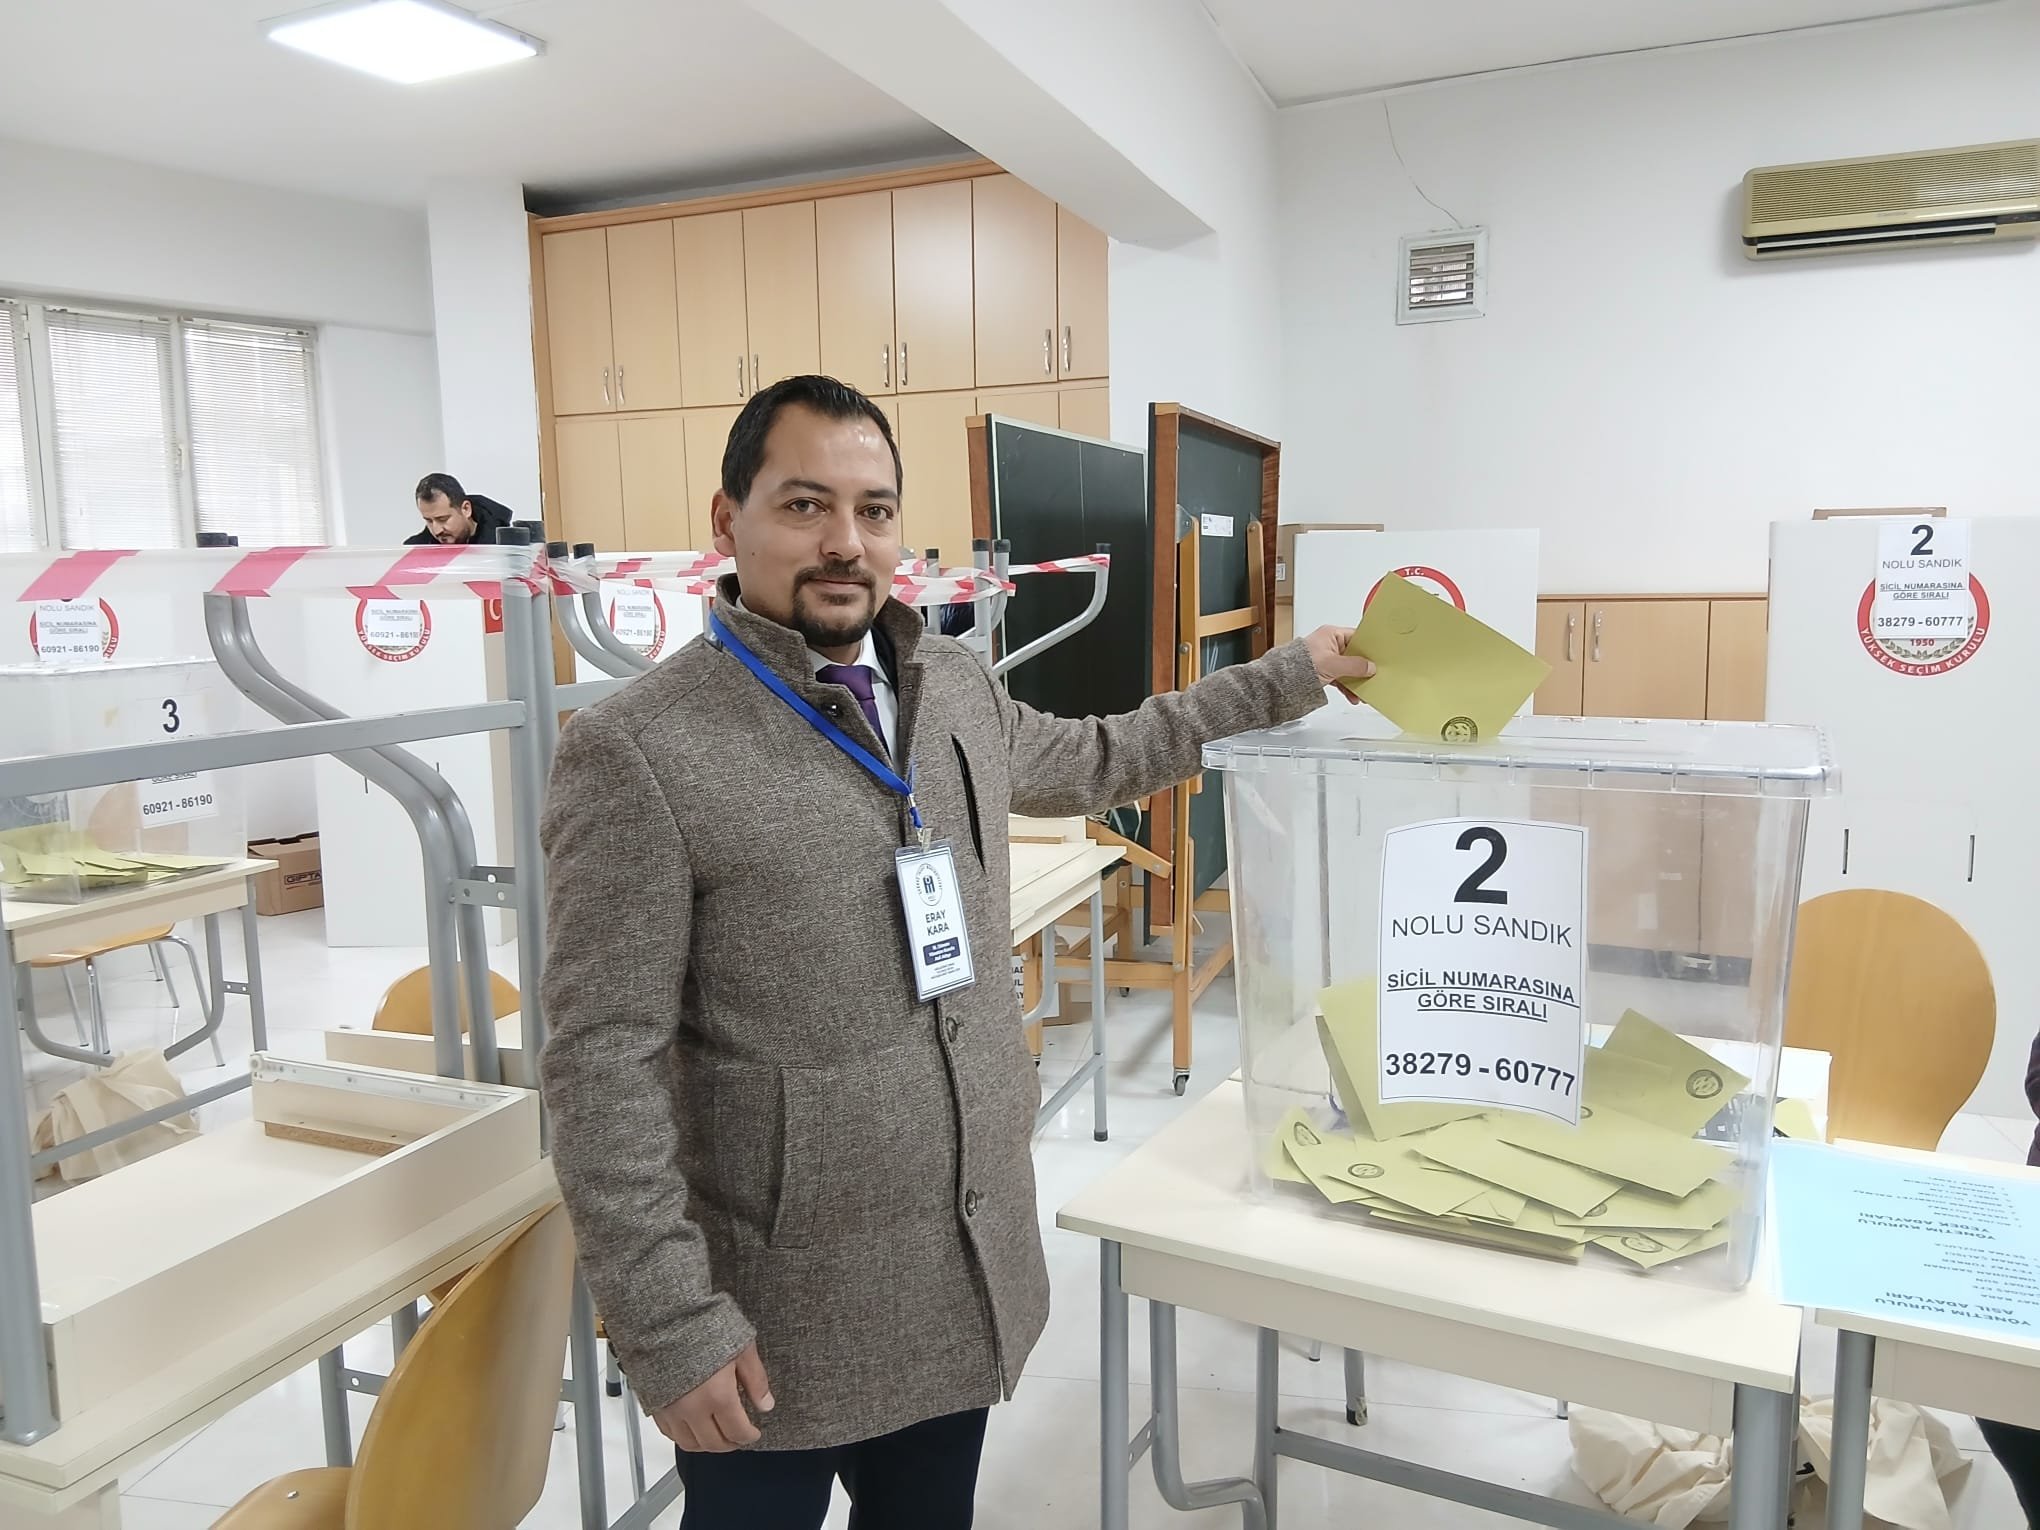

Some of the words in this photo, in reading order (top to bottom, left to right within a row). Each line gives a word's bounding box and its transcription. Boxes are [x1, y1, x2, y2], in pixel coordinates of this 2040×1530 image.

[1910, 525, 1934, 555] 2
[1404, 568, 1424, 576] T.C.
[1882, 560, 1914, 569] NOLU
[1918, 559, 1962, 568] SANDIK
[1878, 617, 1915, 627] 38279
[1925, 616, 1963, 626] 60777
[1859, 628, 1897, 668] YÜKSEK
[1898, 664, 1941, 676] SEÇİM
[1945, 627, 1985, 669] KURULU
[1910, 639, 1935, 647] 1950
[161, 698, 180, 733] 3
[143, 800, 173, 815] 60921
[181, 793, 213, 809] 86190
[1453, 826, 1508, 905] 2
[925, 910, 946, 924] ERAY
[927, 924, 950, 936] KARA
[1391, 914, 1464, 938] NOLU
[1473, 915, 1573, 948] SANDIK
[1387, 968, 1437, 988] SİCİL
[1442, 971, 1575, 1002] NUMARASINA
[1417, 989, 1476, 1009] GÖRE
[1482, 996, 1548, 1019] SIRALI
[1385, 1052, 1472, 1077] 38279
[1495, 1058, 1576, 1097] 60777
